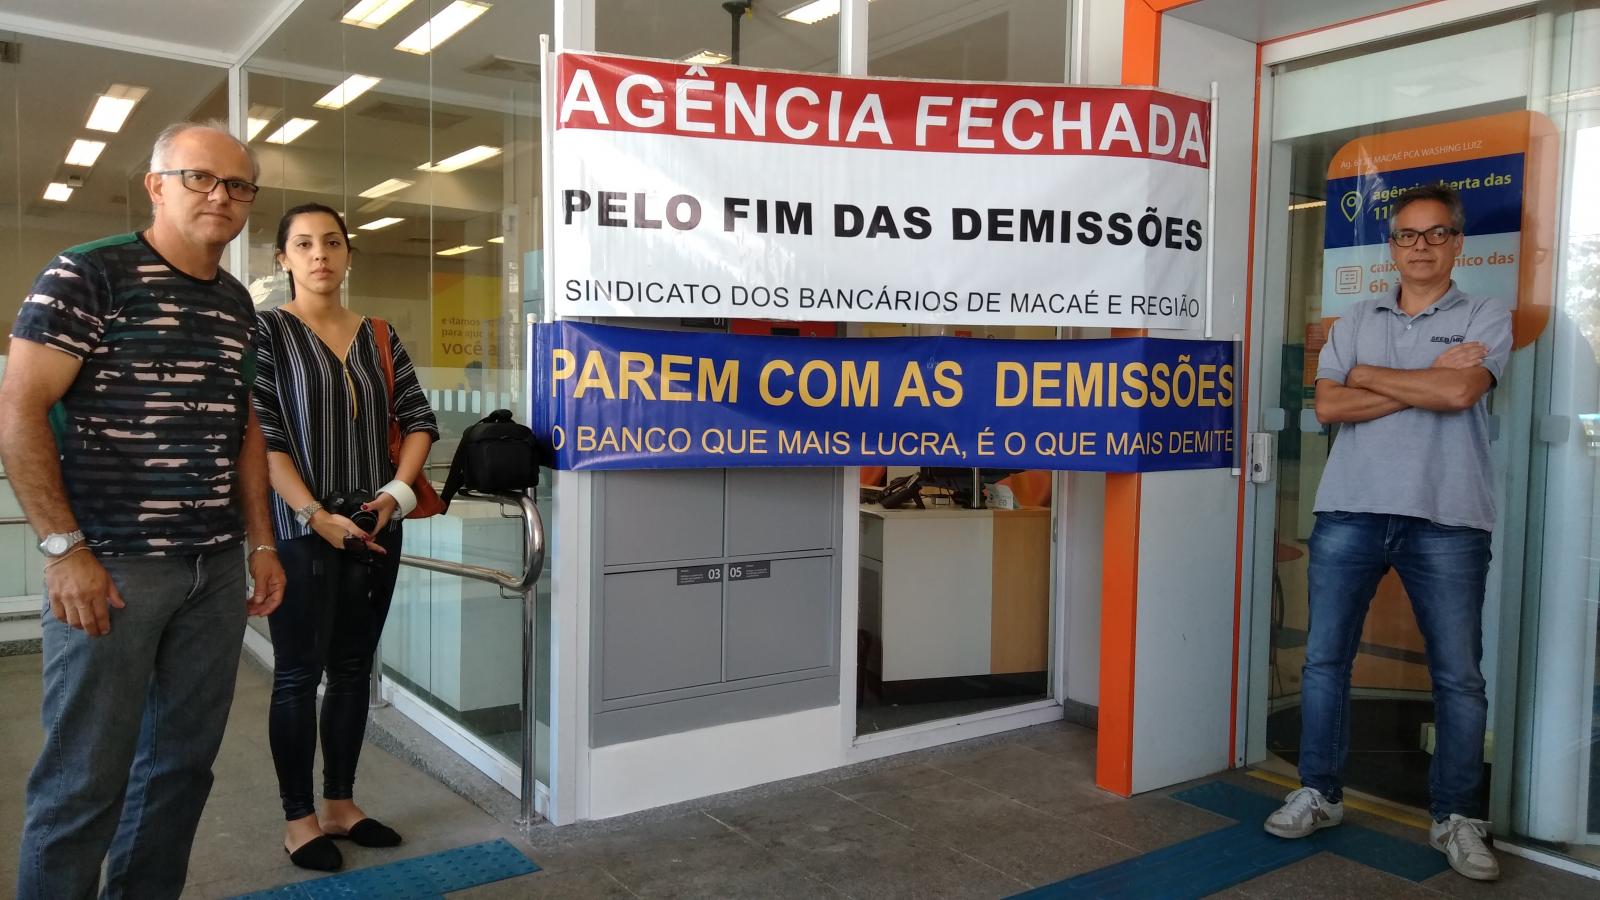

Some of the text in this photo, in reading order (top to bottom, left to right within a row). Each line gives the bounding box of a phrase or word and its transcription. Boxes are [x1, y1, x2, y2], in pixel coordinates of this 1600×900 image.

[559, 63, 1207, 163] AGÊNCIA FECHADA
[1484, 173, 1512, 187] das
[562, 189, 1203, 252] PELO FIM DAS DEMISSÕES
[1487, 251, 1514, 264] das
[1369, 279, 1389, 293] 6h
[565, 279, 1200, 318] SINDICATO DOS BANCÁRIOS DE MACAÉ E REGIÃO
[441, 341, 482, 355] você
[552, 348, 1233, 408] PAREM COM AS DEMISSÕES
[551, 425, 1233, 459] O BANCO QUE MAIS LUCRA, É O QUE MAIS DEMITE
[708, 569, 721, 580] 03
[730, 567, 742, 578] 05
